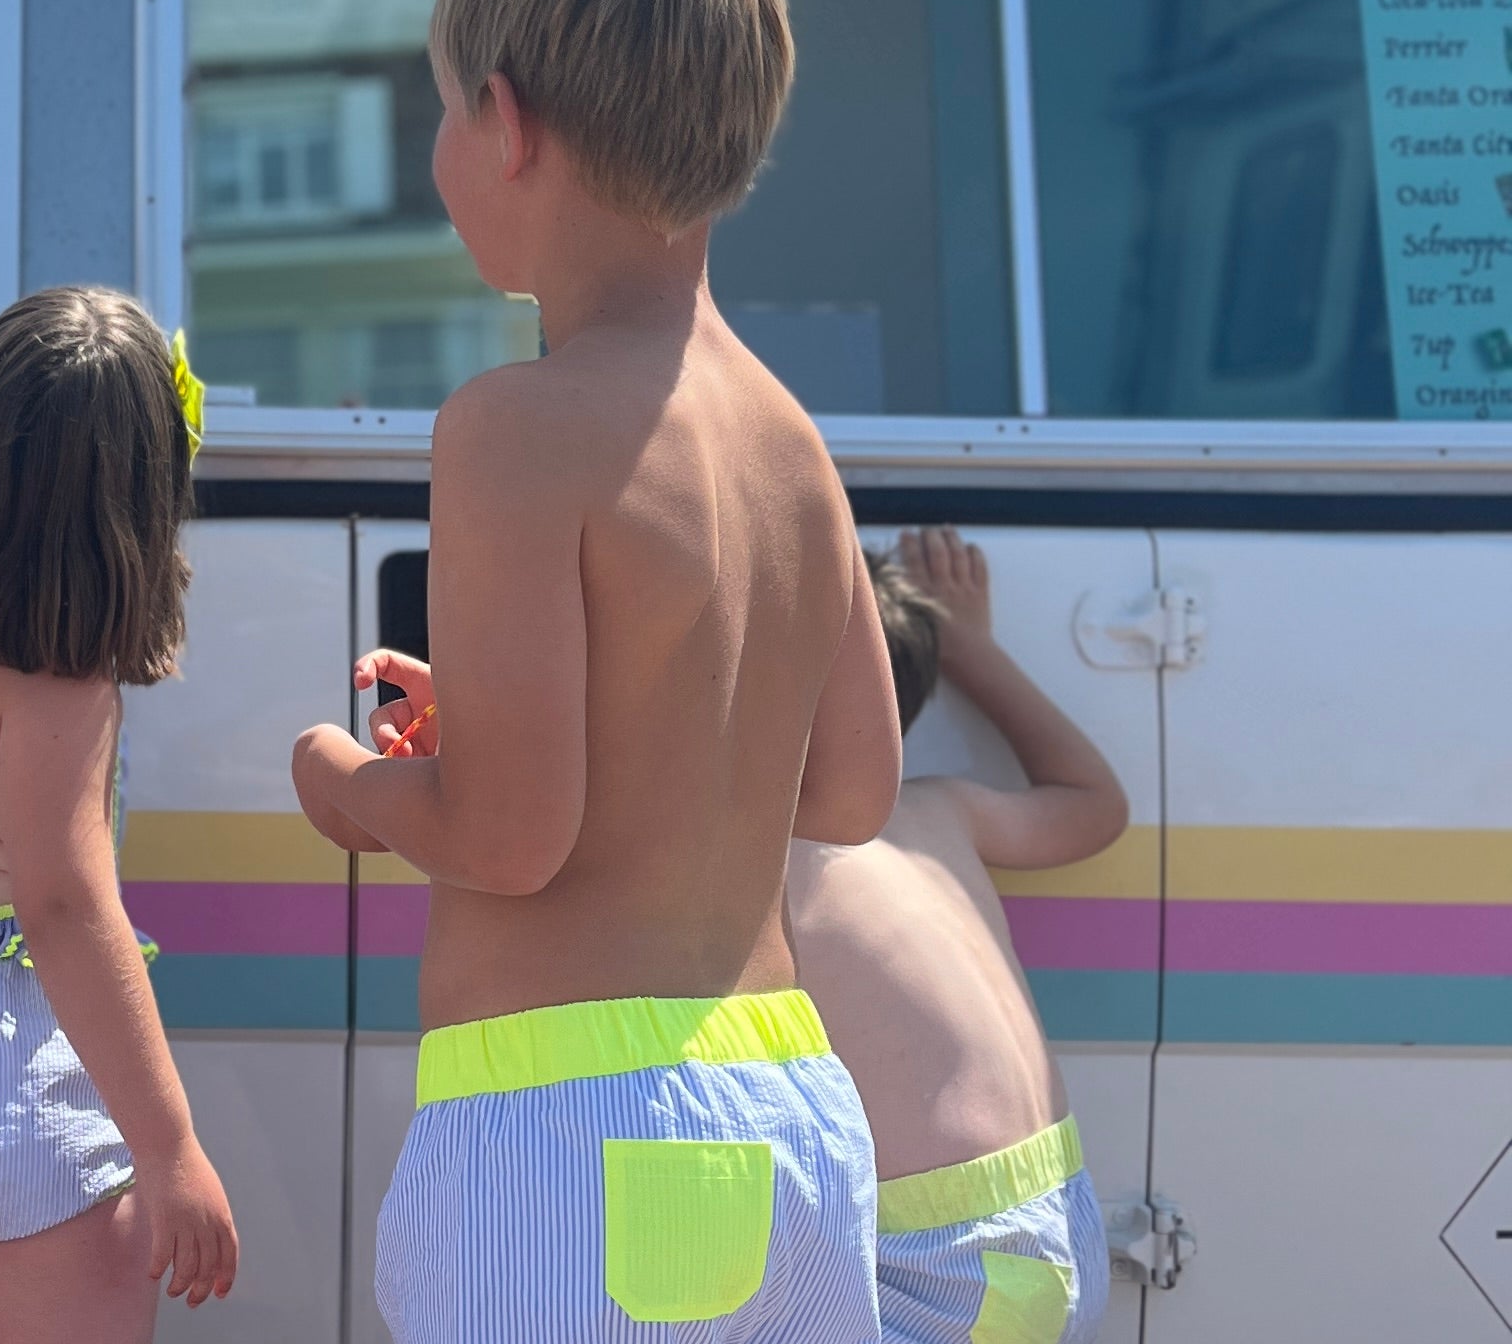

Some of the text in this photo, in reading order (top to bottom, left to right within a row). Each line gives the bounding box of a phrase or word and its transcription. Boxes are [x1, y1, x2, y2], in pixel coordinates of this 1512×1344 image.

[1384, 31, 1469, 59] Perrier
[1385, 85, 1460, 107] Fanta
[1389, 134, 1465, 156] Fanta
[1396, 179, 1461, 207] Oasis
[1402, 222, 1512, 277] Schweppe
[1415, 379, 1512, 420] Orangin
